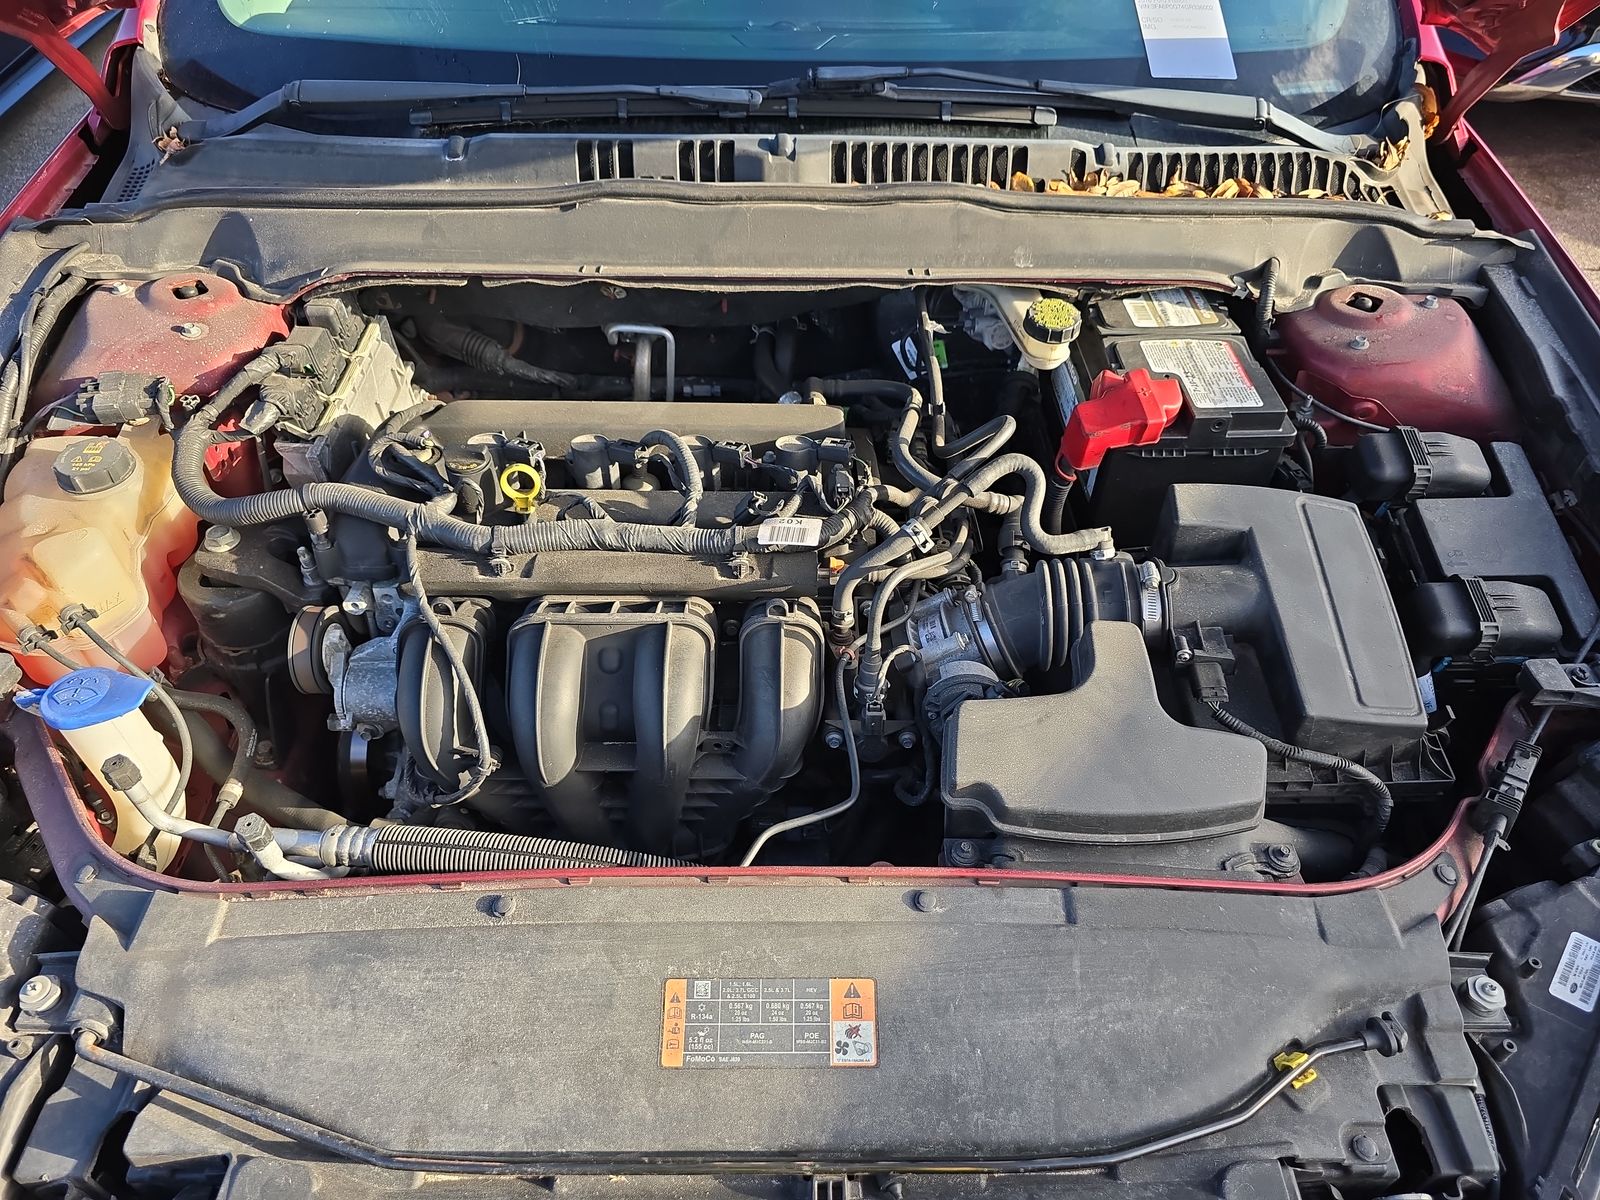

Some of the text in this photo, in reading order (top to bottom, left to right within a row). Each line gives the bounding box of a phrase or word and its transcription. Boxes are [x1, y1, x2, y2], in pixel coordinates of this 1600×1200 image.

[745, 1002, 753, 1011] kg
[782, 1002, 790, 1011] kg
[816, 1002, 824, 1011] kg
[690, 1013, 713, 1021] R-134a
[750, 1032, 765, 1040] PAG
[688, 1043, 714, 1051] (155 cc)
[686, 1055, 716, 1063] FoMoCo
